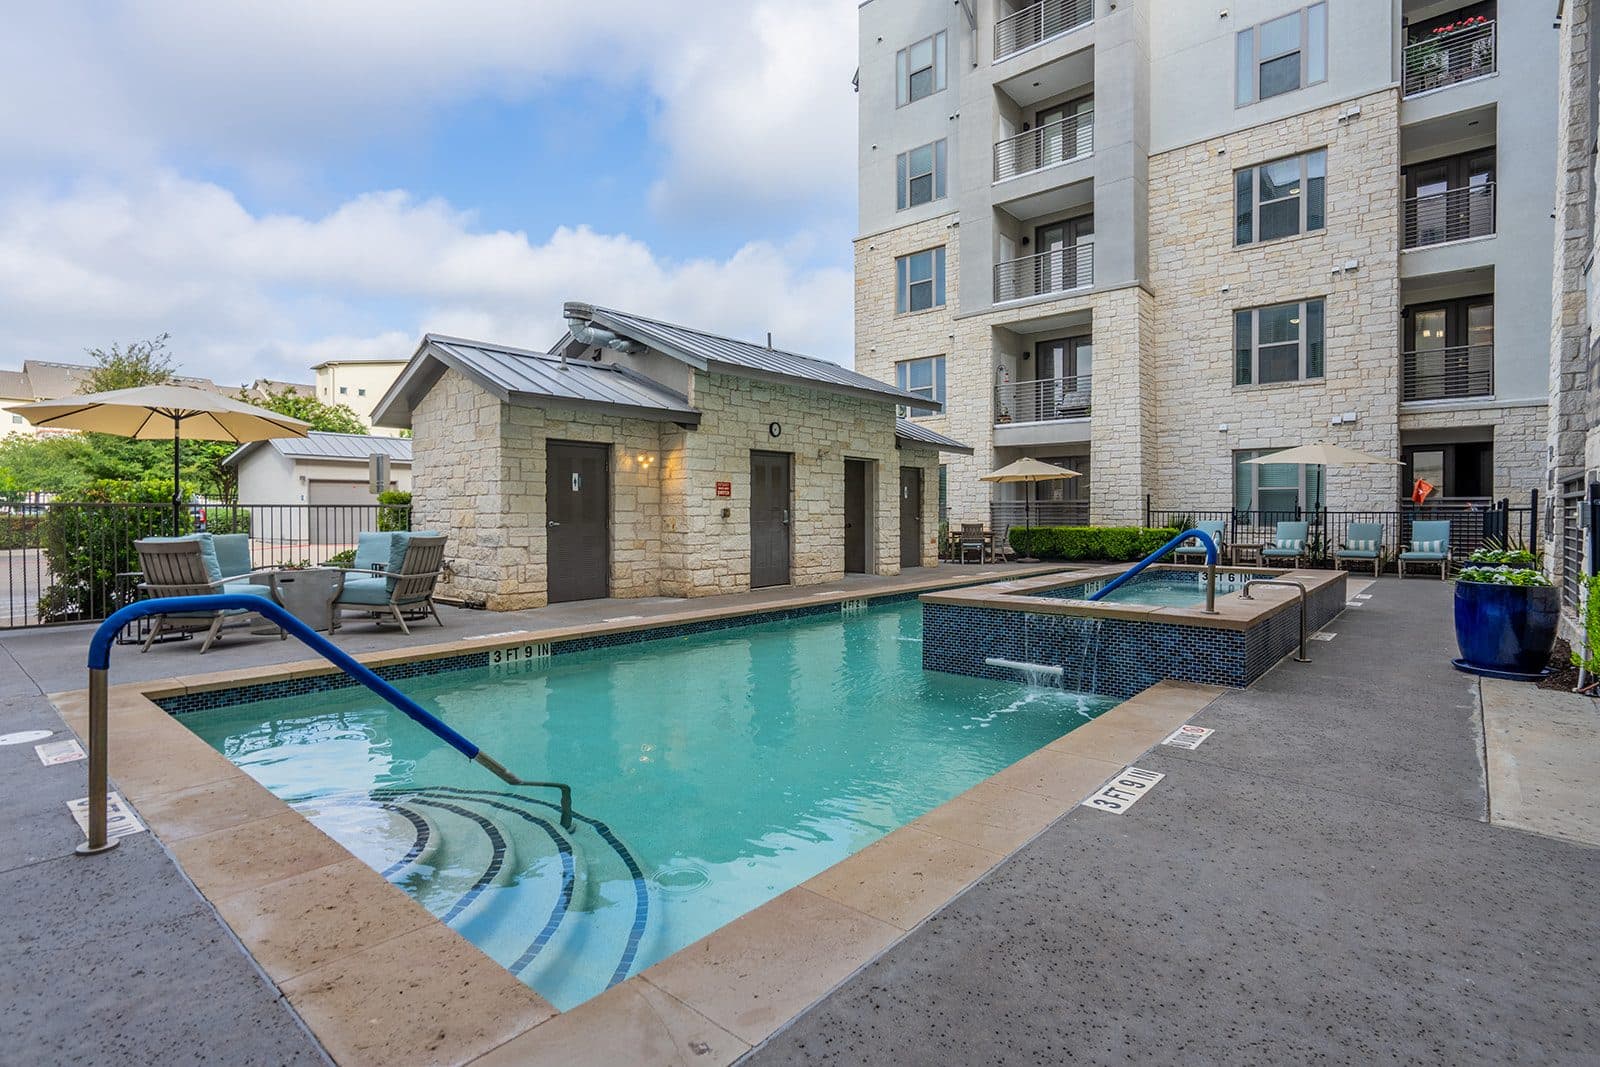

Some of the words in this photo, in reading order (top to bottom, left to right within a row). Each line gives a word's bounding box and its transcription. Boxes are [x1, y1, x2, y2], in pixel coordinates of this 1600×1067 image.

[1202, 572, 1209, 581] 3
[1228, 573, 1236, 582] 6
[1240, 572, 1251, 583] IN
[493, 650, 502, 663] 3
[506, 646, 520, 662] FT
[525, 645, 533, 658] 9
[537, 643, 549, 657] IN
[1126, 768, 1160, 782] IN
[1118, 779, 1147, 789] 9
[1102, 786, 1136, 802] FT
[1093, 799, 1122, 809] 3
